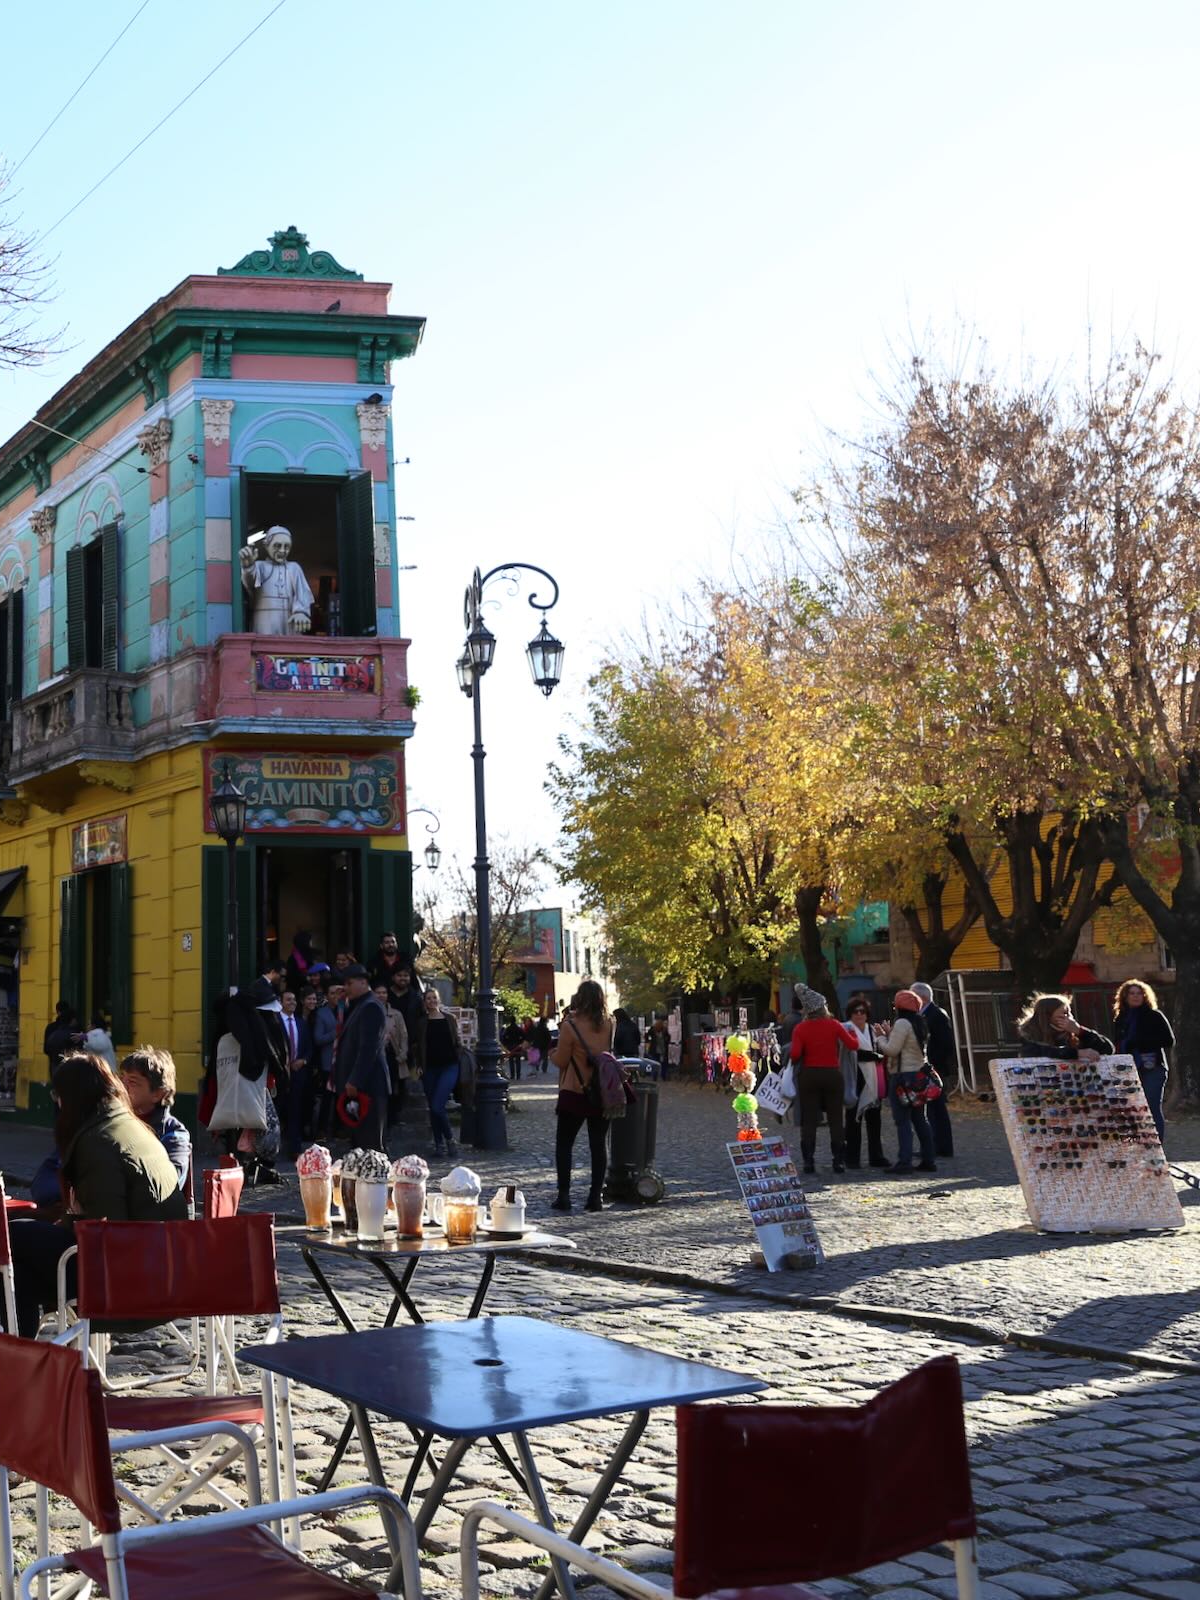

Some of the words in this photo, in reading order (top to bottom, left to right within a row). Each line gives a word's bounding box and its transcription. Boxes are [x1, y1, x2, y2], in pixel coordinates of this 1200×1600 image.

[271, 760, 343, 776] HAVANNA
[238, 777, 375, 807] CAMINITO
[758, 1087, 786, 1110] Shop
